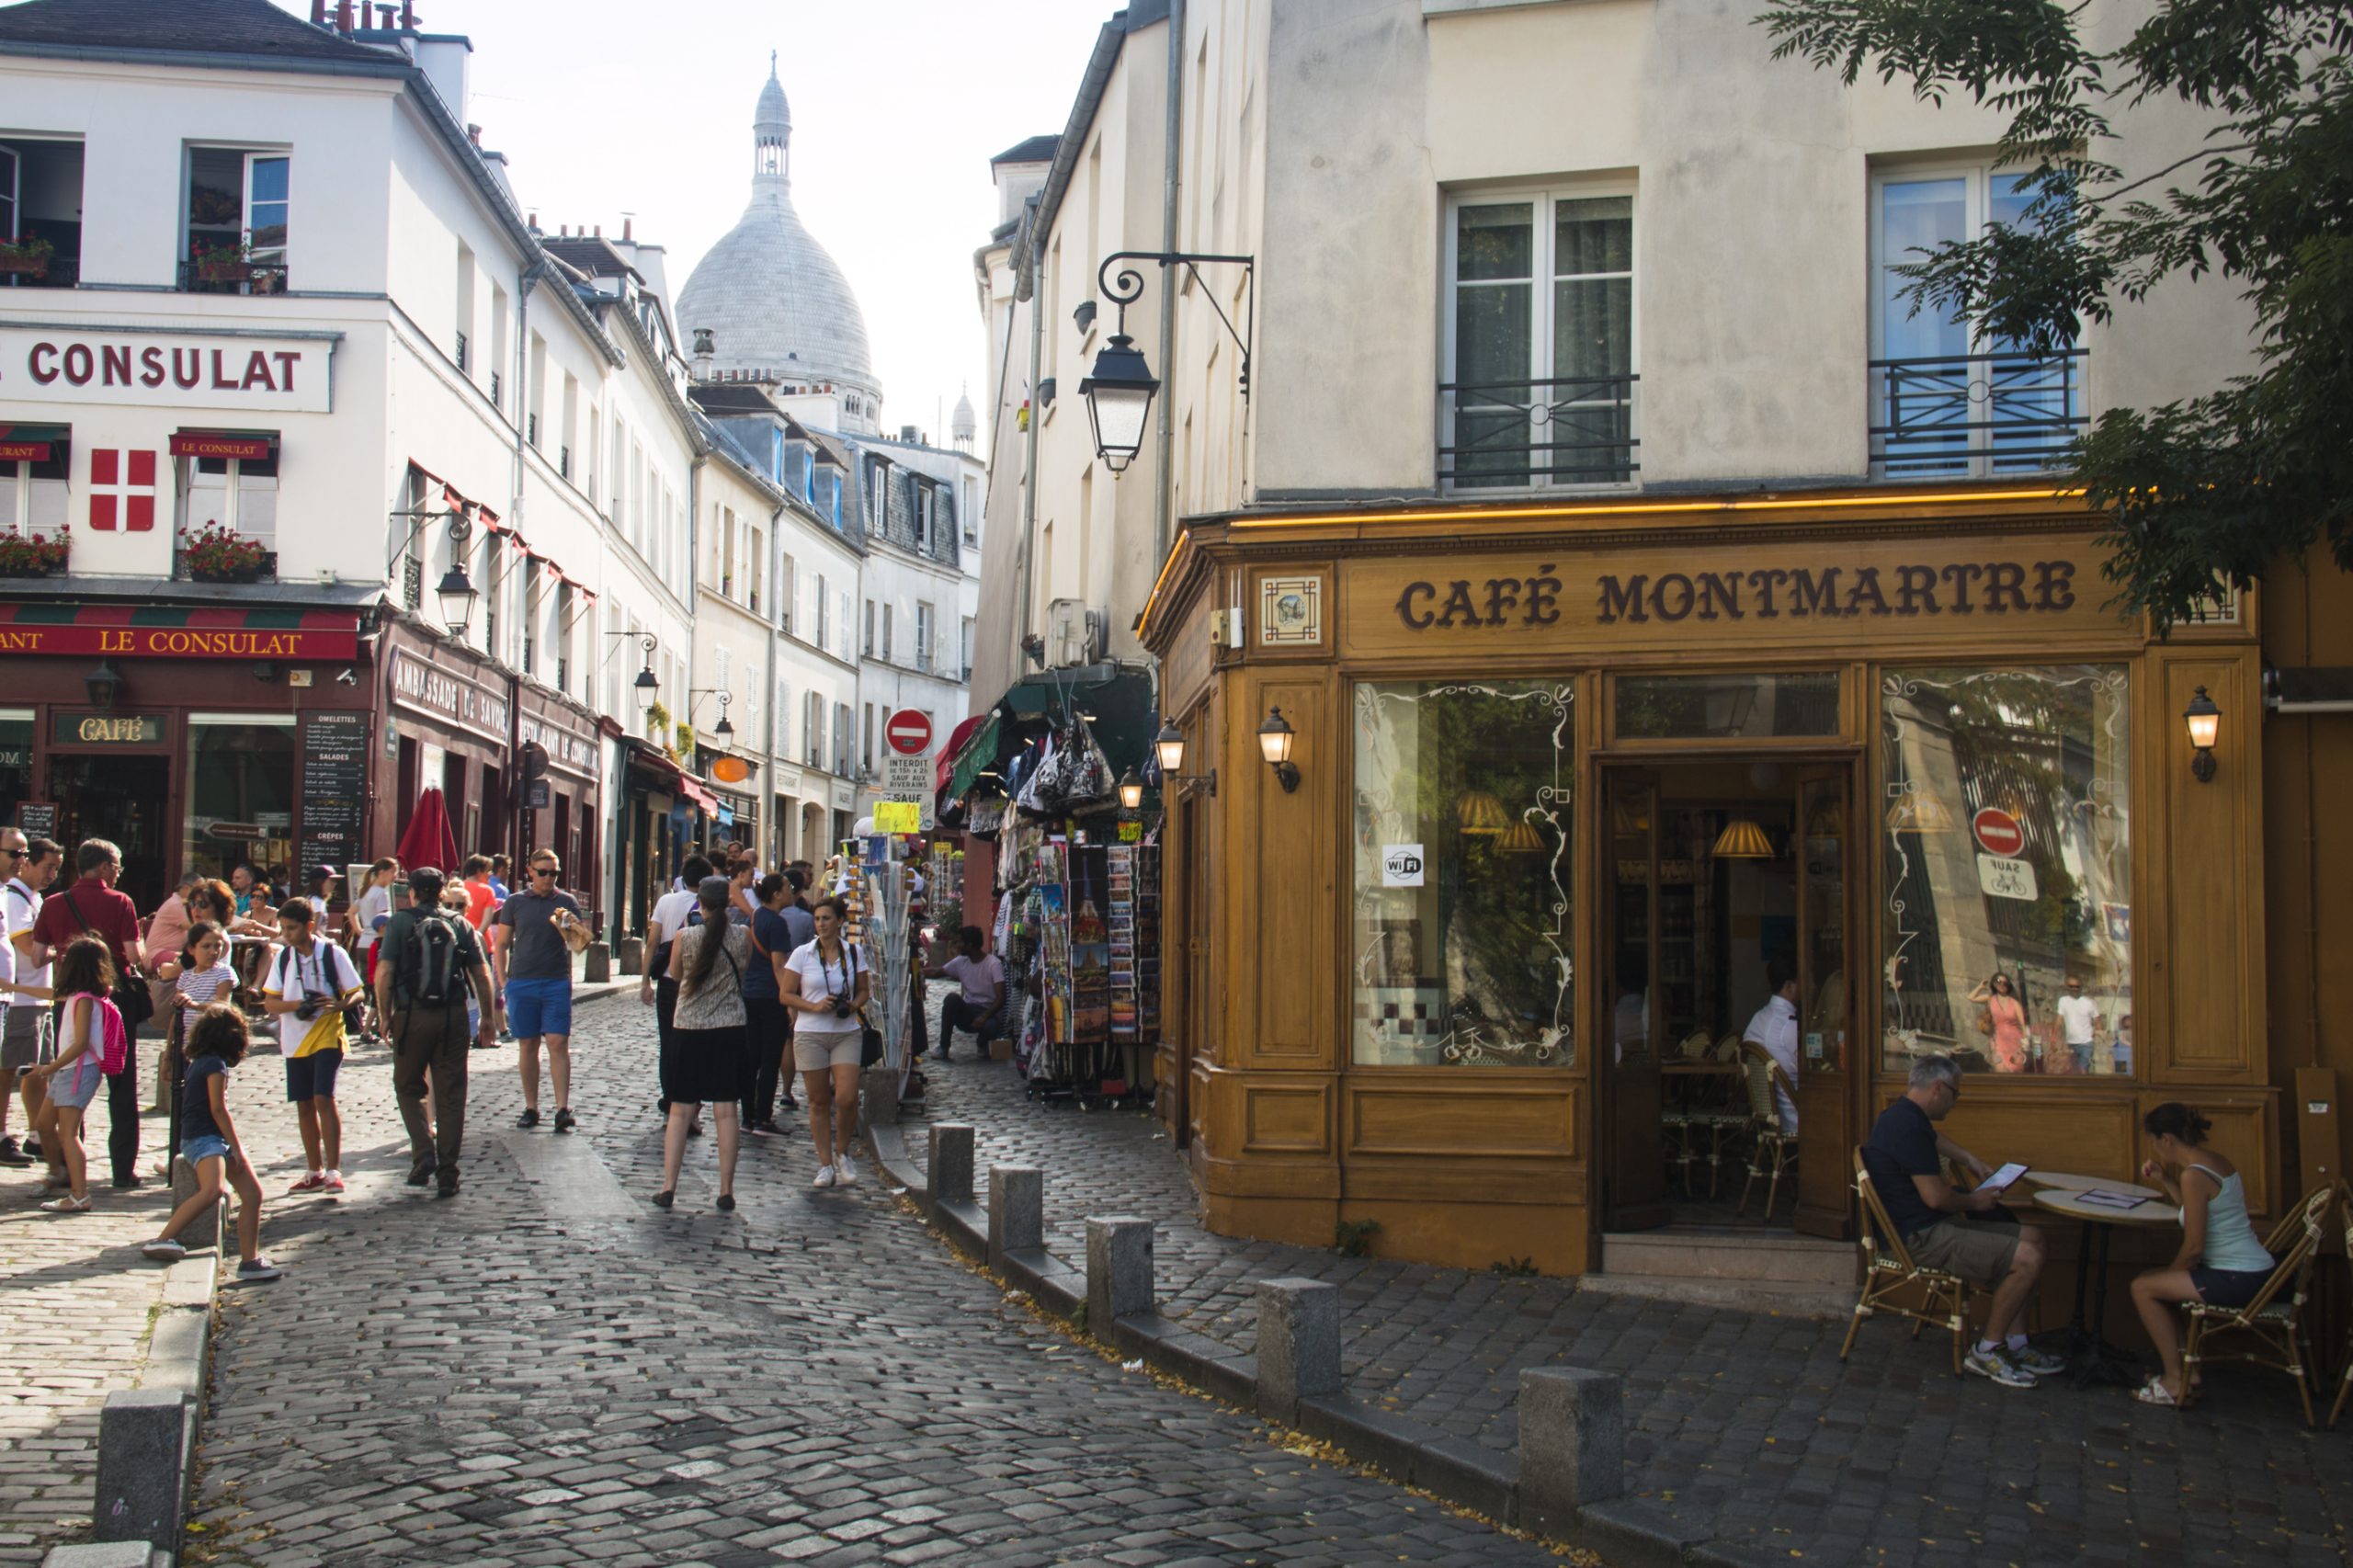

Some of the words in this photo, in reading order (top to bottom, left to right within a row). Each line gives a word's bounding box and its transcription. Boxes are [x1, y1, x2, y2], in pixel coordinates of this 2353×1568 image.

[28, 342, 301, 392] CONSULAT
[182, 442, 196, 452] LE
[199, 443, 256, 455] CONSULAT
[1395, 563, 1563, 630] CAFÉ
[1597, 559, 2076, 624] MONTMARTRE
[98, 631, 135, 652] LE
[149, 631, 301, 654] CONSULAT
[395, 660, 457, 712] AMBASSADE
[318, 715, 357, 723] OMELETTES
[79, 715, 143, 742] CAFÉ
[319, 753, 349, 761] SALADES
[889, 759, 928, 767] INTERDIT
[893, 793, 922, 803] SAUF
